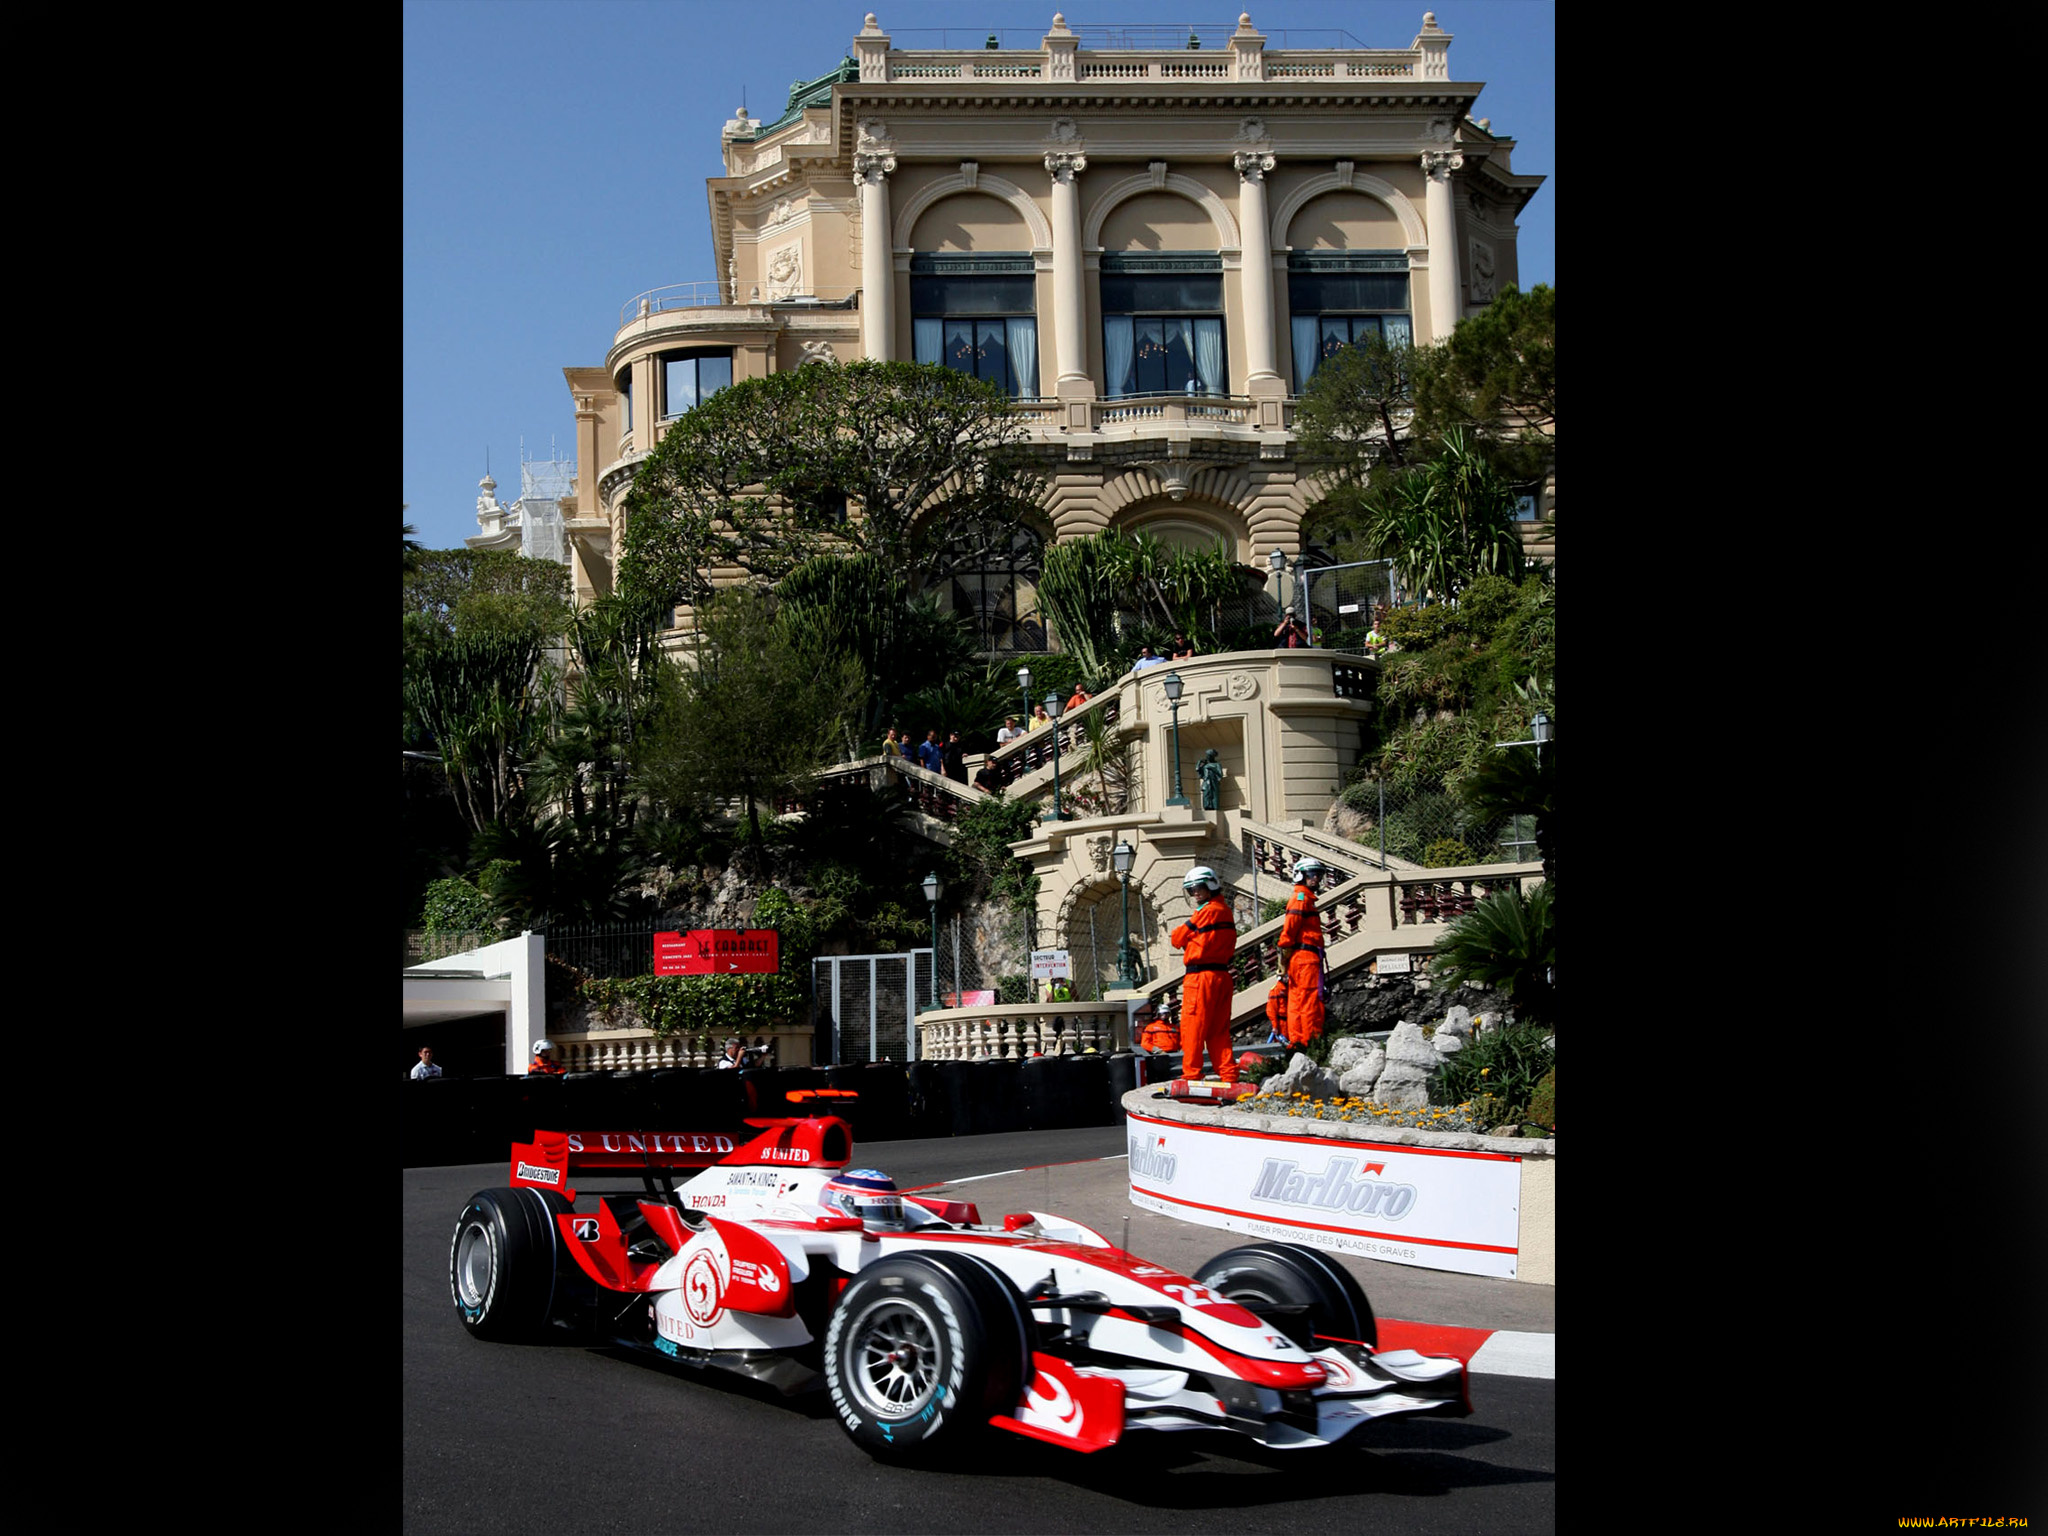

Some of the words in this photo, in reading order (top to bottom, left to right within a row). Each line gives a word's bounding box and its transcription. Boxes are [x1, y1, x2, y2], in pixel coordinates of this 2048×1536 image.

[715, 940, 769, 952] CABARET
[601, 1134, 734, 1153] UNITED
[772, 1147, 810, 1162] UNITED
[517, 1162, 559, 1183] BRIDGESTONE
[1252, 1157, 1416, 1220] Marlboro
[692, 1195, 726, 1208] HONDA
[1247, 1222, 1271, 1234] FUMER
[1272, 1227, 1315, 1243] PROVOQUE
[1316, 1235, 1334, 1245] DES
[1335, 1238, 1377, 1253] MALADIES
[1379, 1245, 1417, 1260] GRAVES
